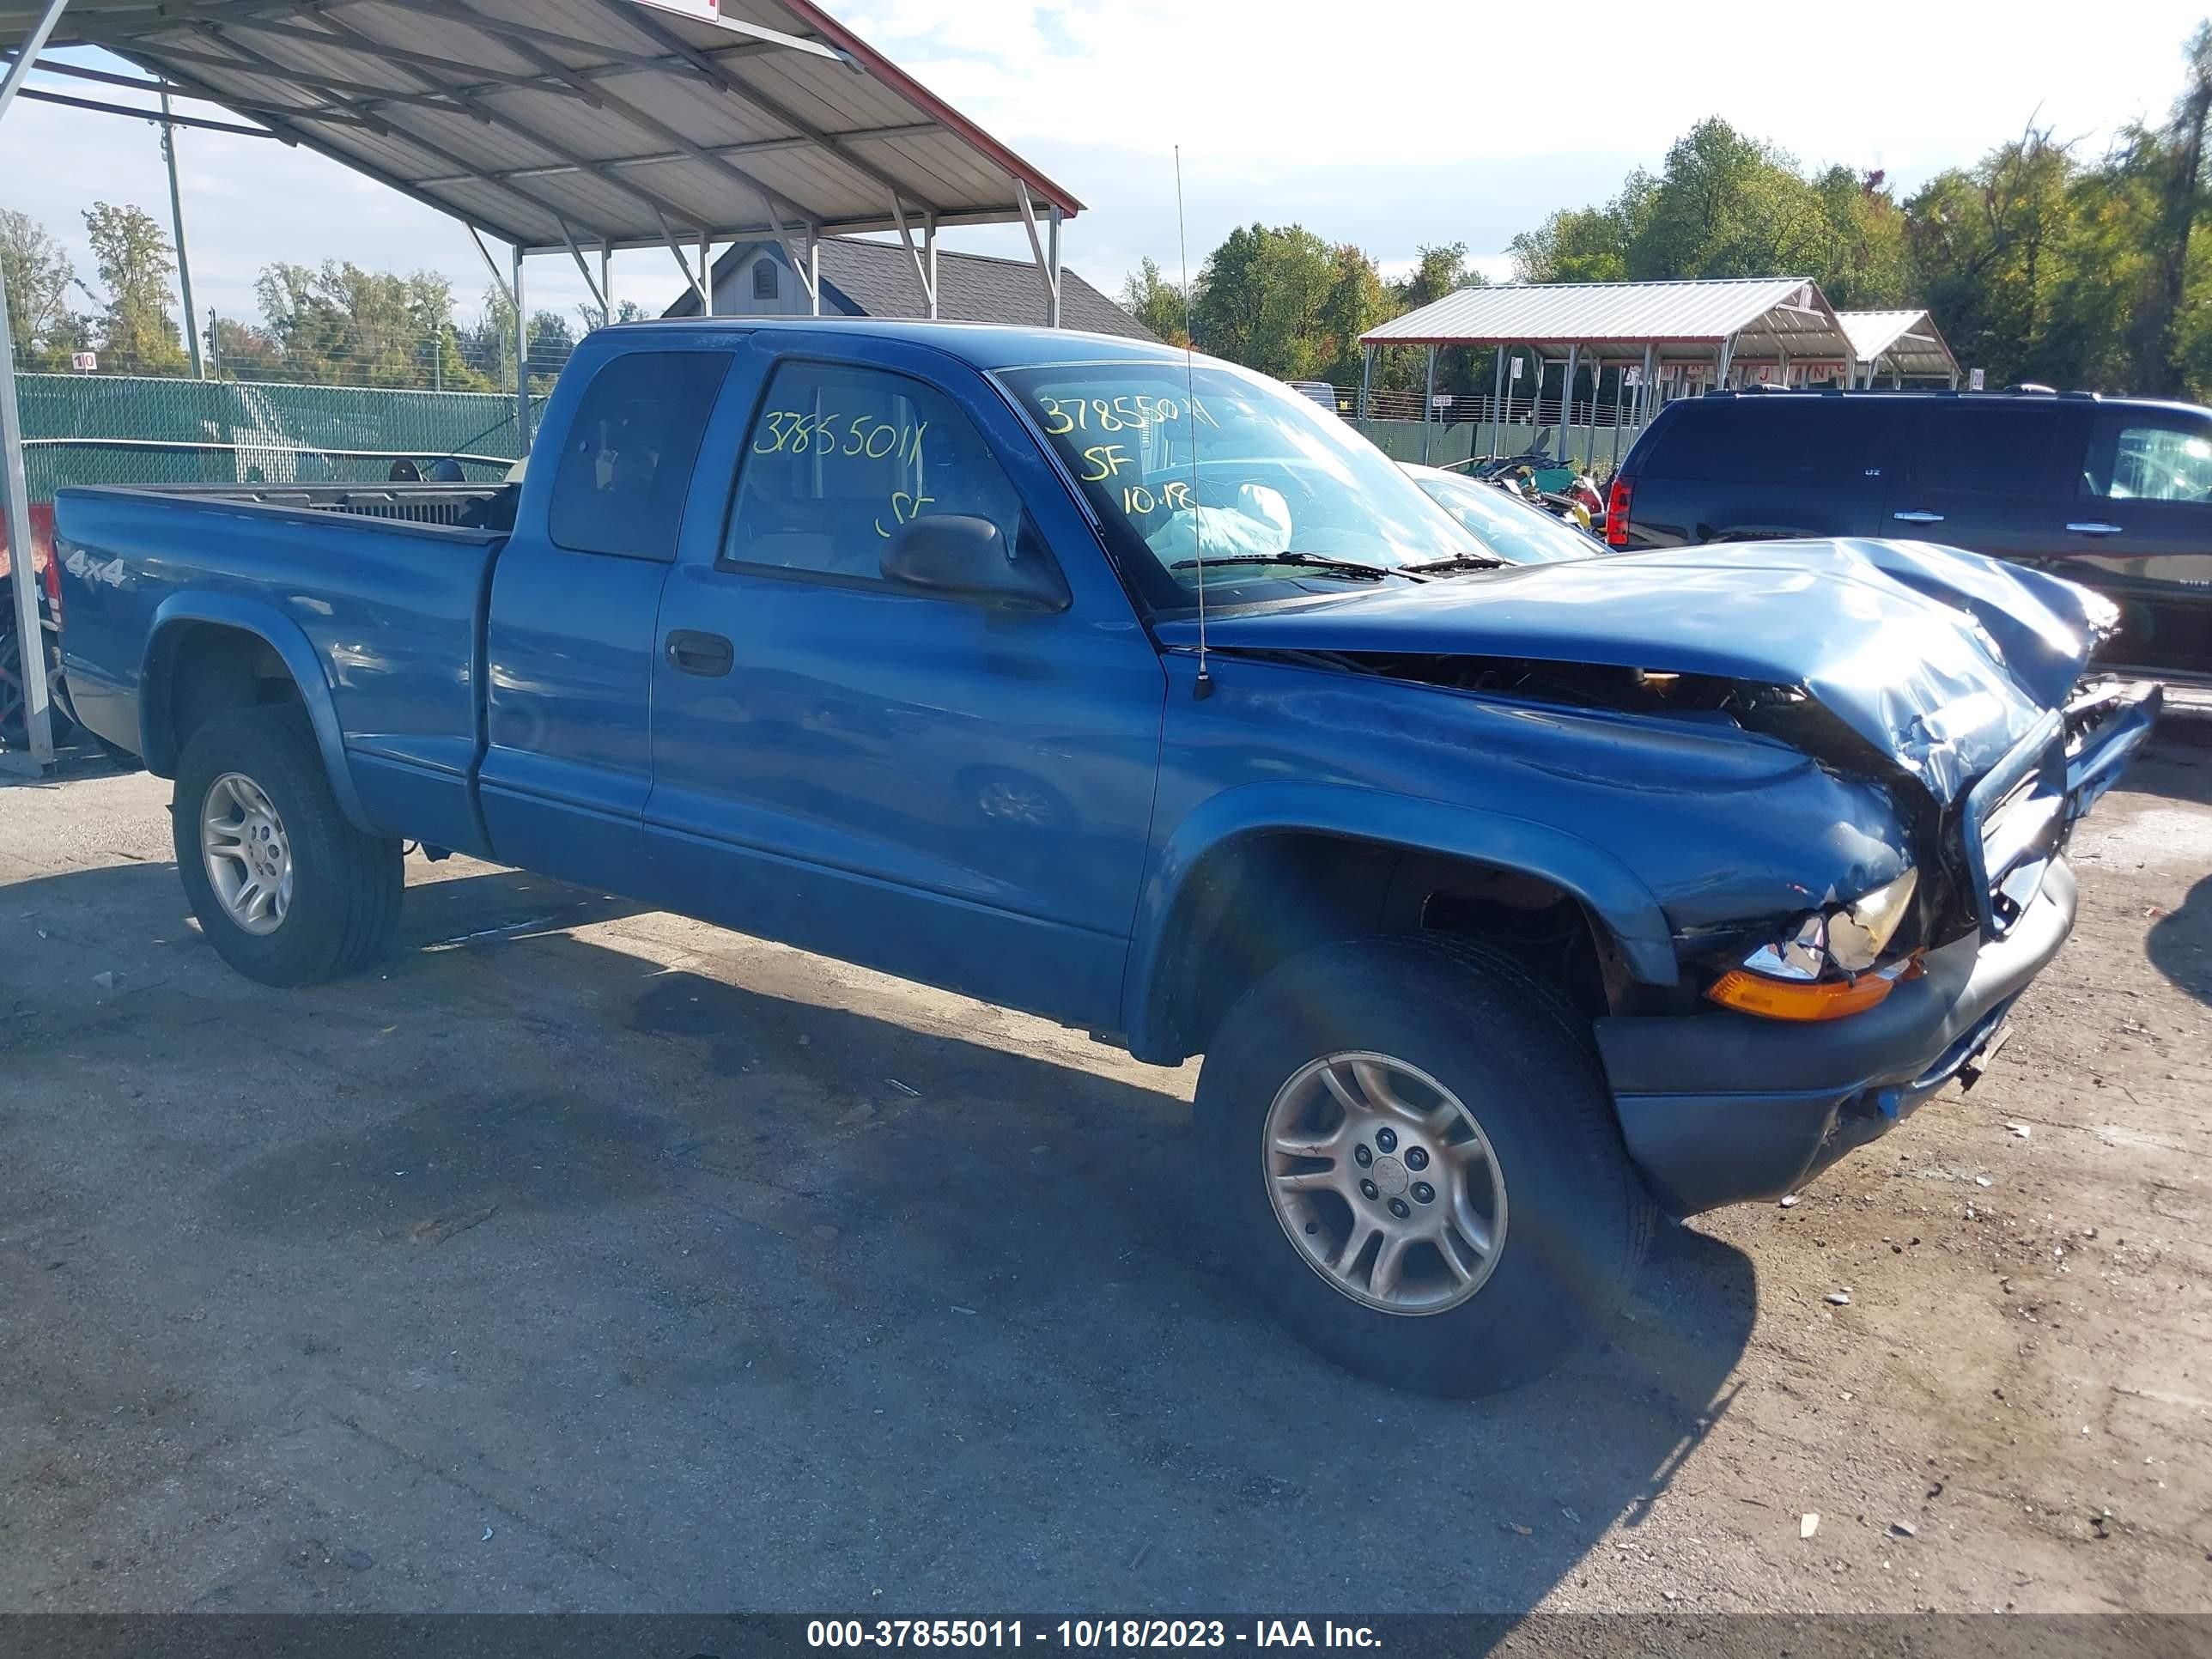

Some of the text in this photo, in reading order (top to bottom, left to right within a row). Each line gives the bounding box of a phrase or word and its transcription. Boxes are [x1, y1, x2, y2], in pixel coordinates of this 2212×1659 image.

[74, 355, 94, 367] 10
[1040, 397, 1220, 434] 37855011
[1080, 445, 1134, 481] SF
[64, 550, 127, 588] 4x4
